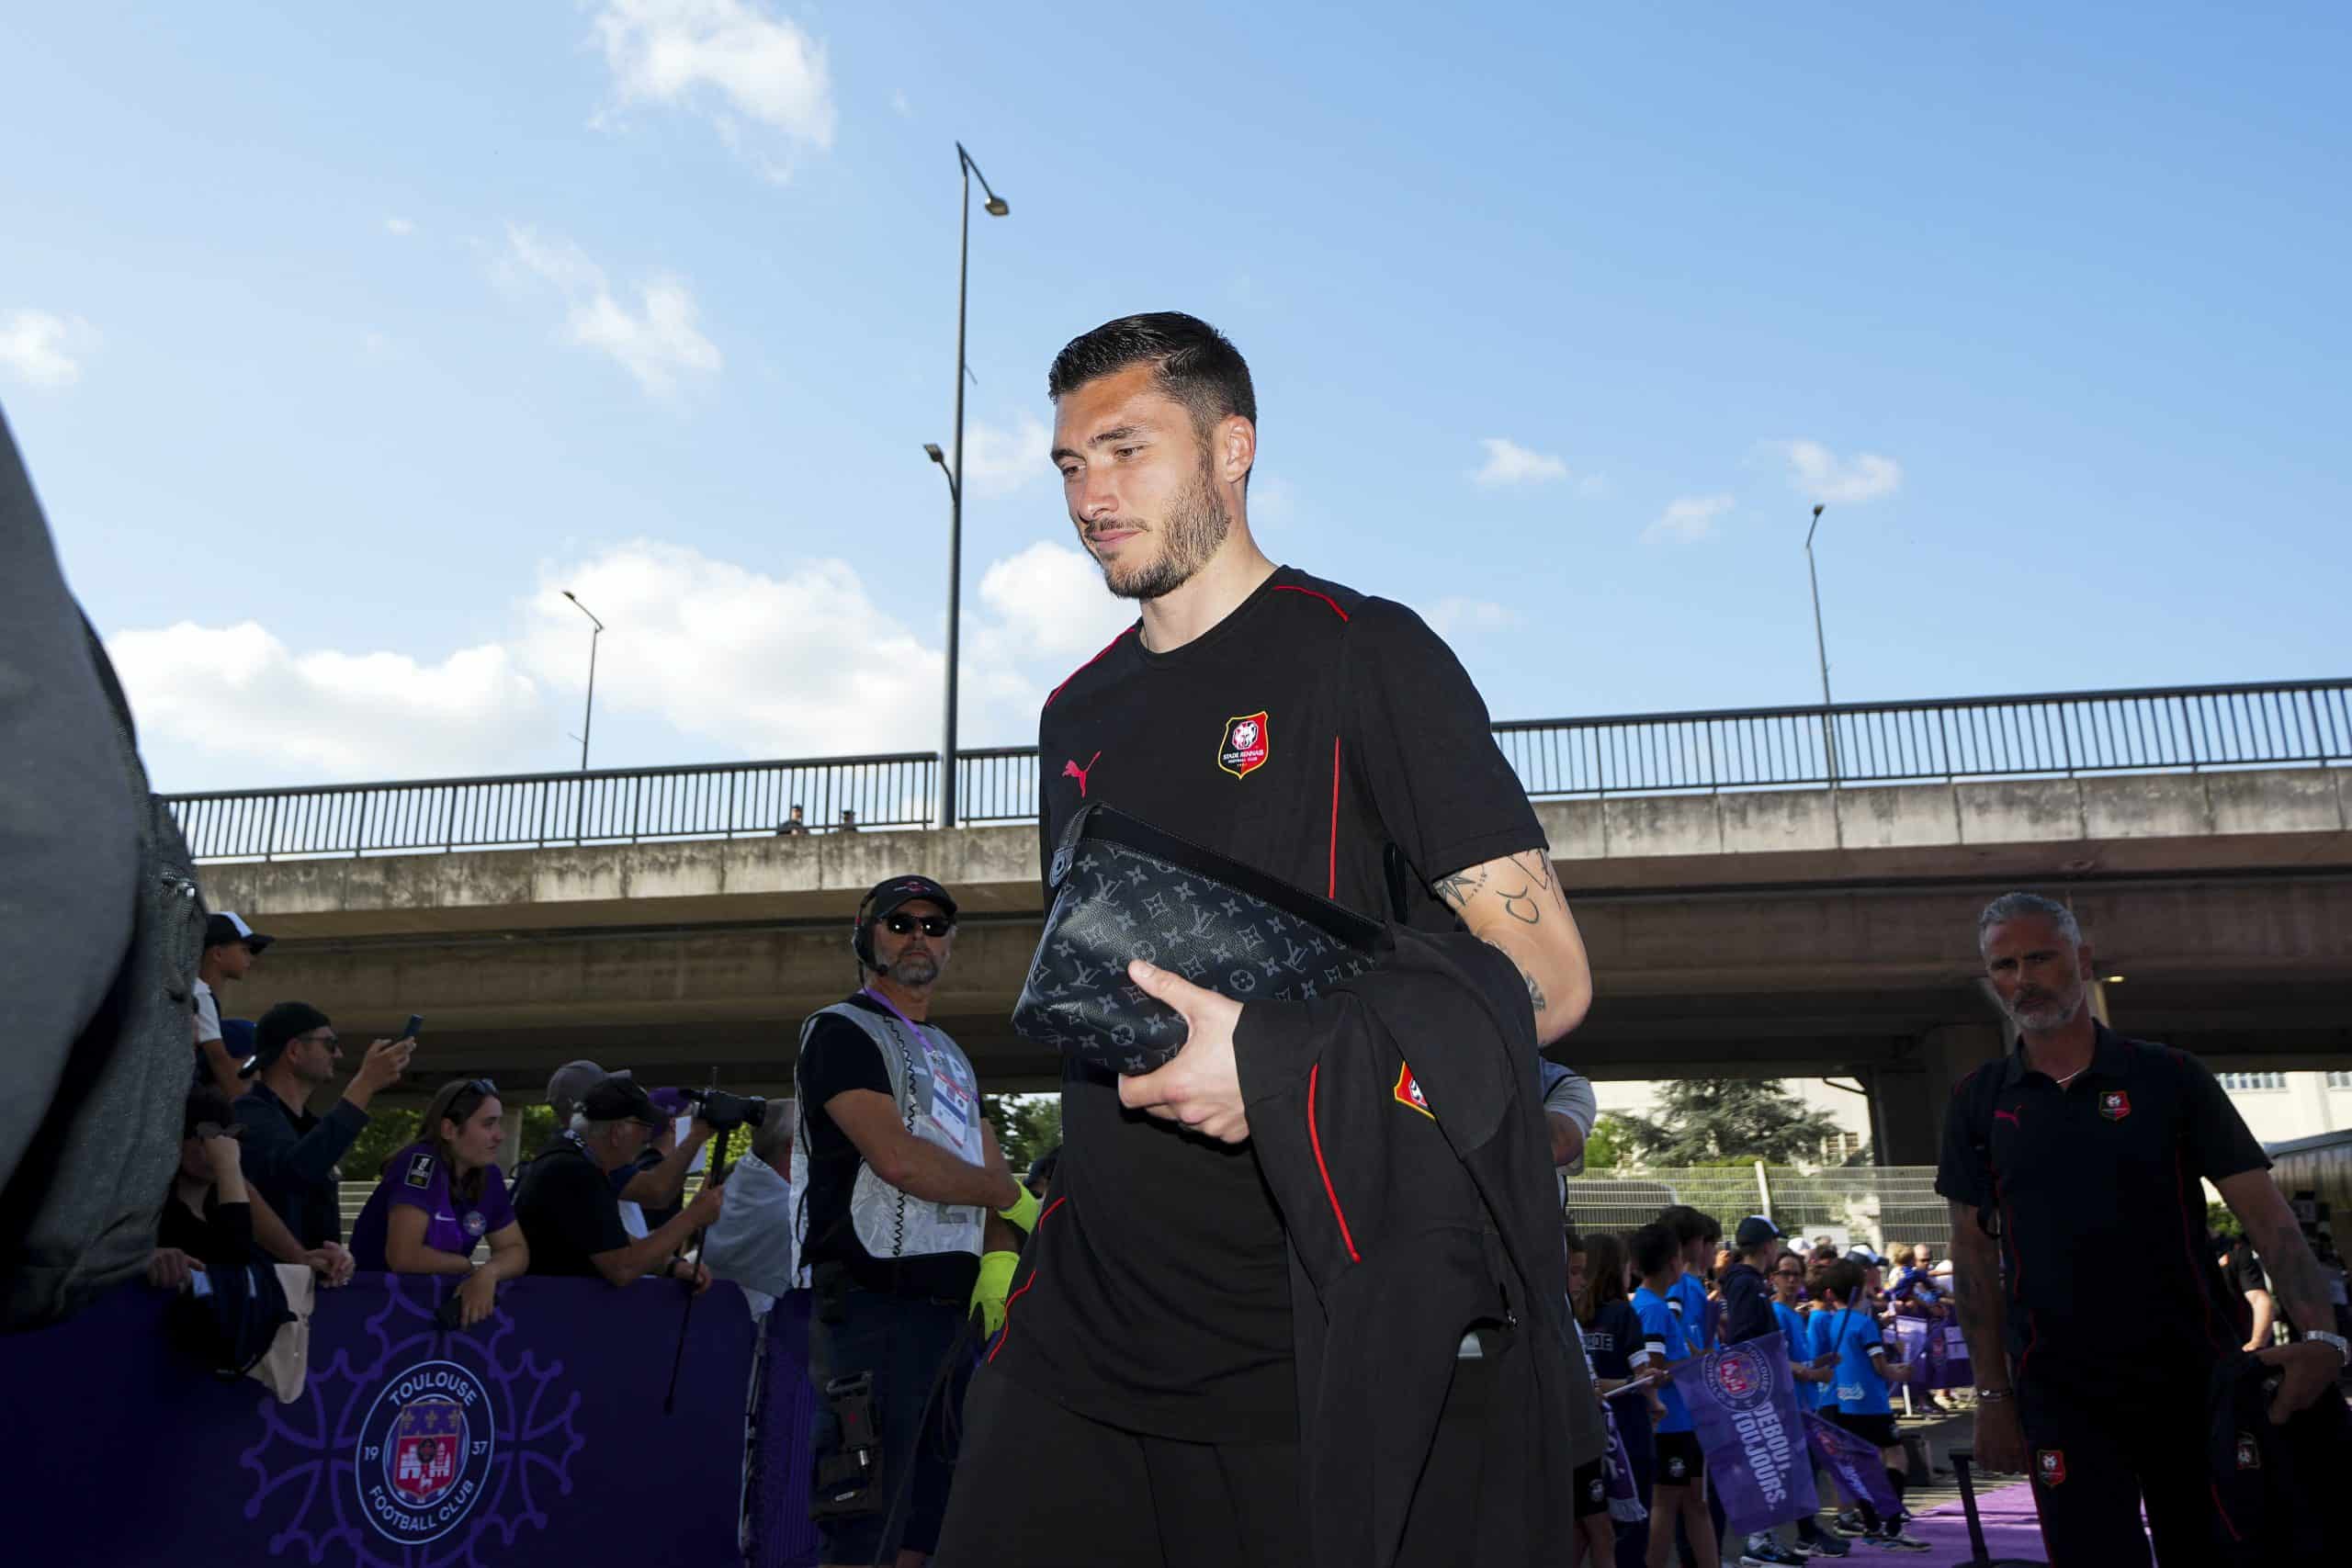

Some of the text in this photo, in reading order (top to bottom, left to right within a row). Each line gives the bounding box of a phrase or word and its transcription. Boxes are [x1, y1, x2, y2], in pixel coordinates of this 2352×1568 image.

[390, 1371, 477, 1406] TOULOUSE
[365, 1446, 379, 1461] 19
[471, 1441, 489, 1456] 37
[368, 1480, 473, 1530] FOOTBALL CLUB
